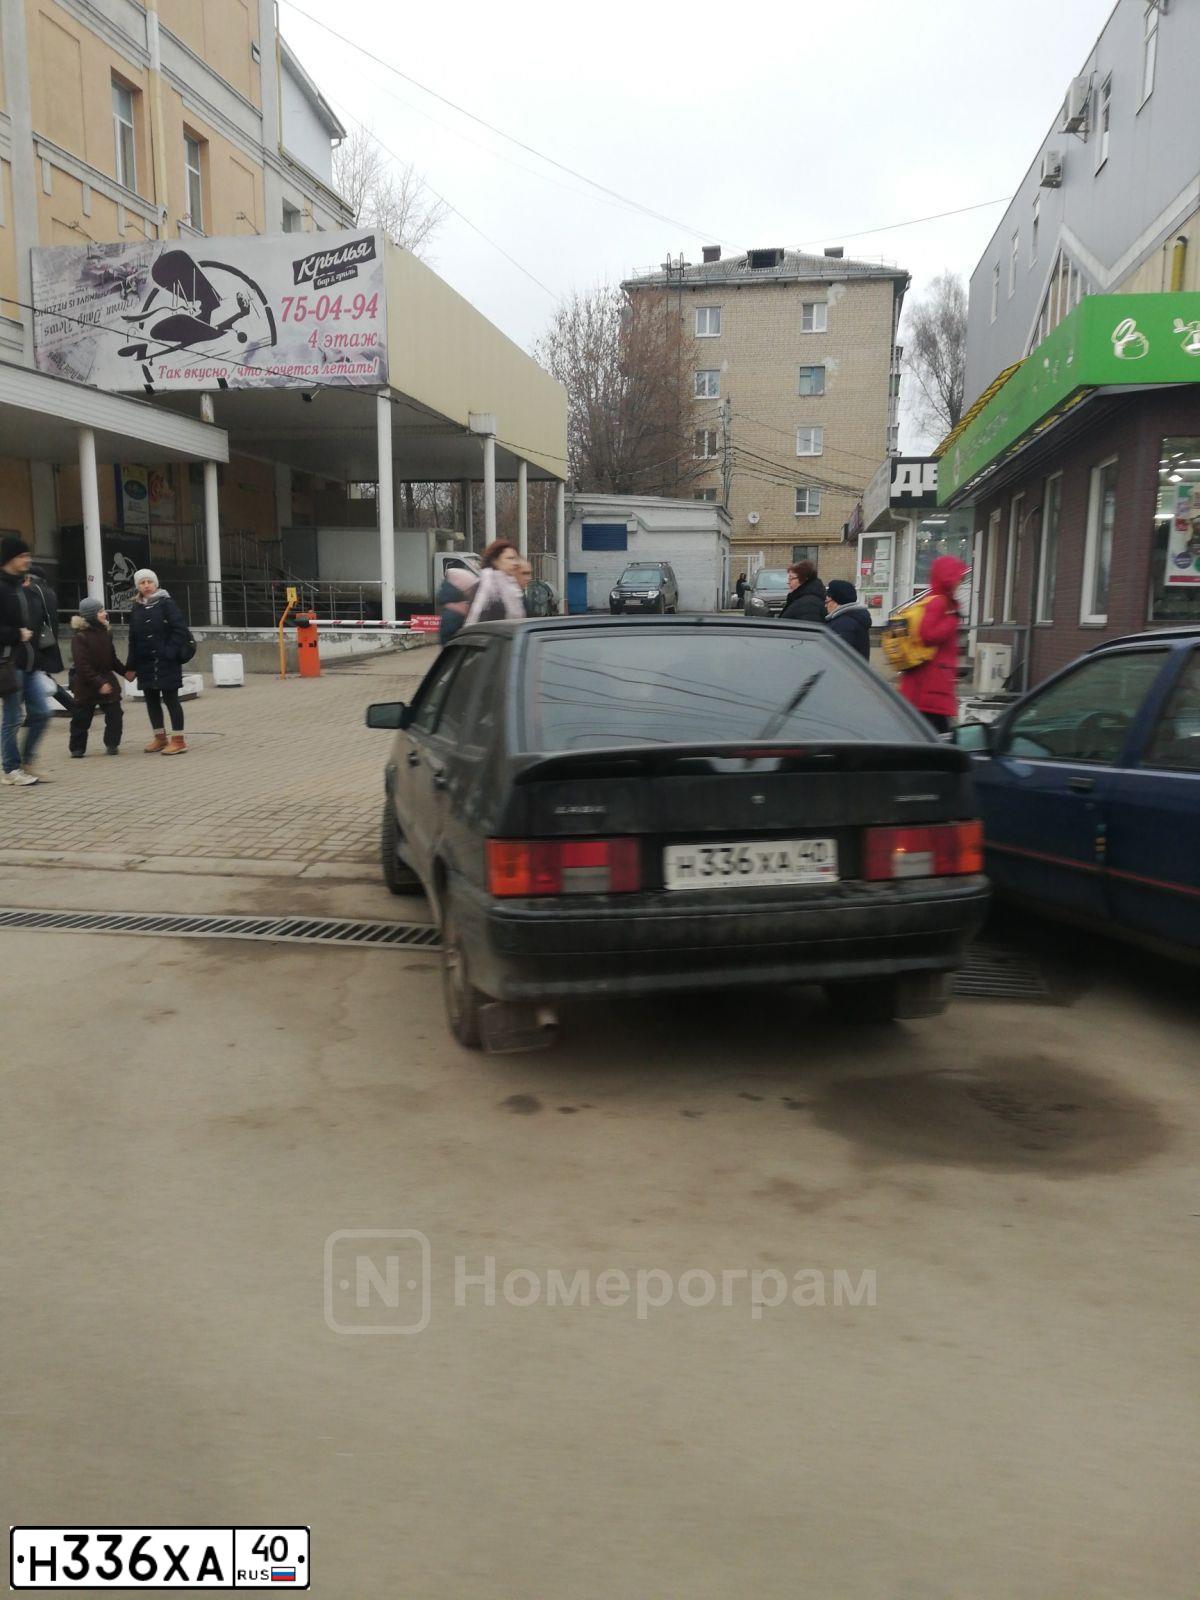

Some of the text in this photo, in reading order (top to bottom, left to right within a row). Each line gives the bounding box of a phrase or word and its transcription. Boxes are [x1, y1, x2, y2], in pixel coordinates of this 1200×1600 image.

[297, 242, 372, 281] Крылья
[280, 293, 379, 322] 75-04-94
[307, 329, 378, 348] 4 этаж
[158, 356, 379, 380] Так вкусно, что хочется летать!
